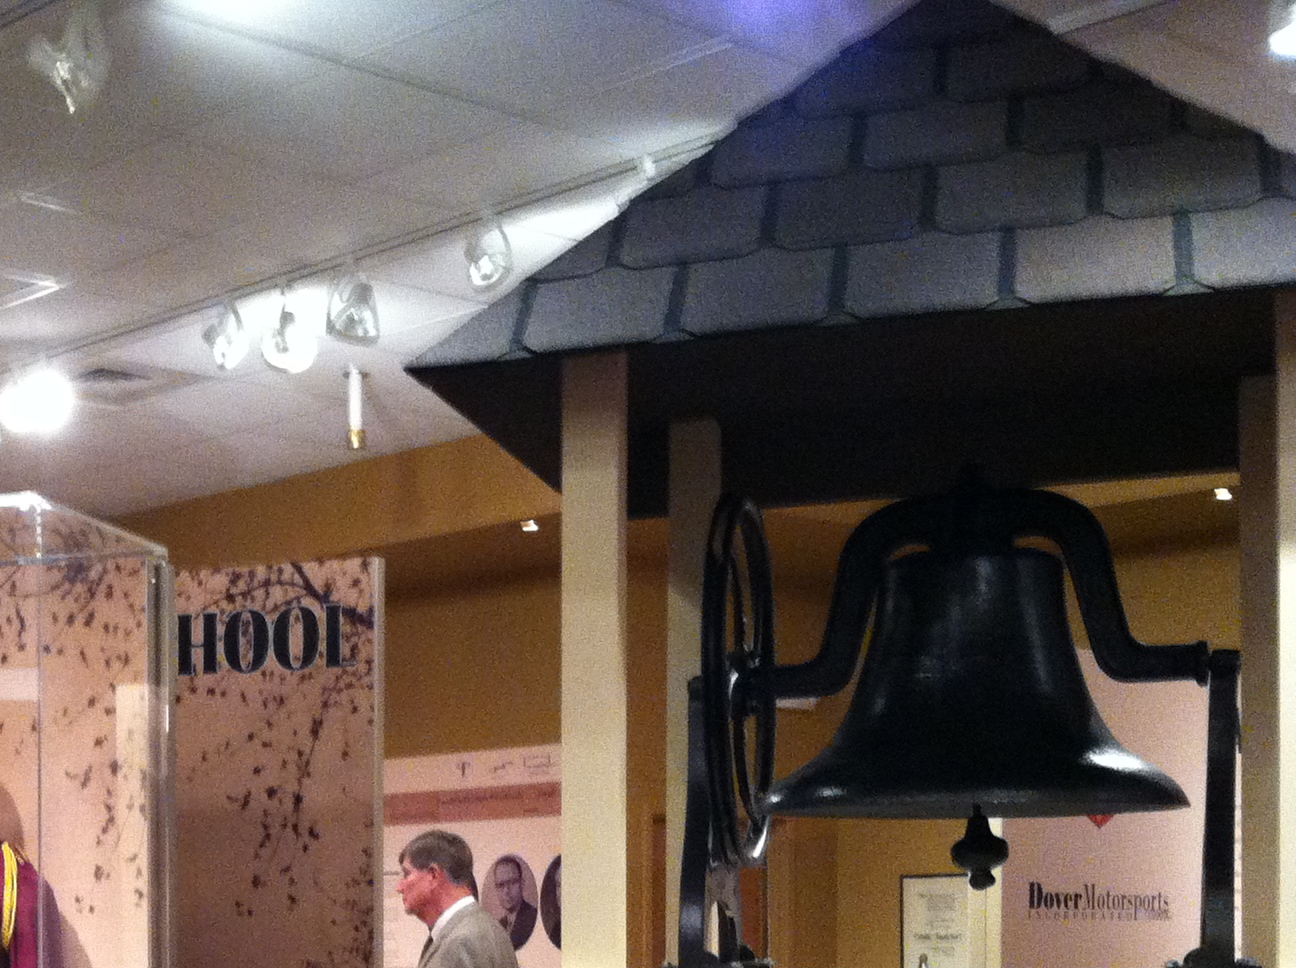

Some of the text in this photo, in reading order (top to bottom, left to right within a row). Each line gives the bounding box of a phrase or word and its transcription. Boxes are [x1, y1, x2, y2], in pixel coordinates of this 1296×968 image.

[178, 604, 357, 676] HOOL
[1028, 881, 1169, 920] Dover Motorsports
